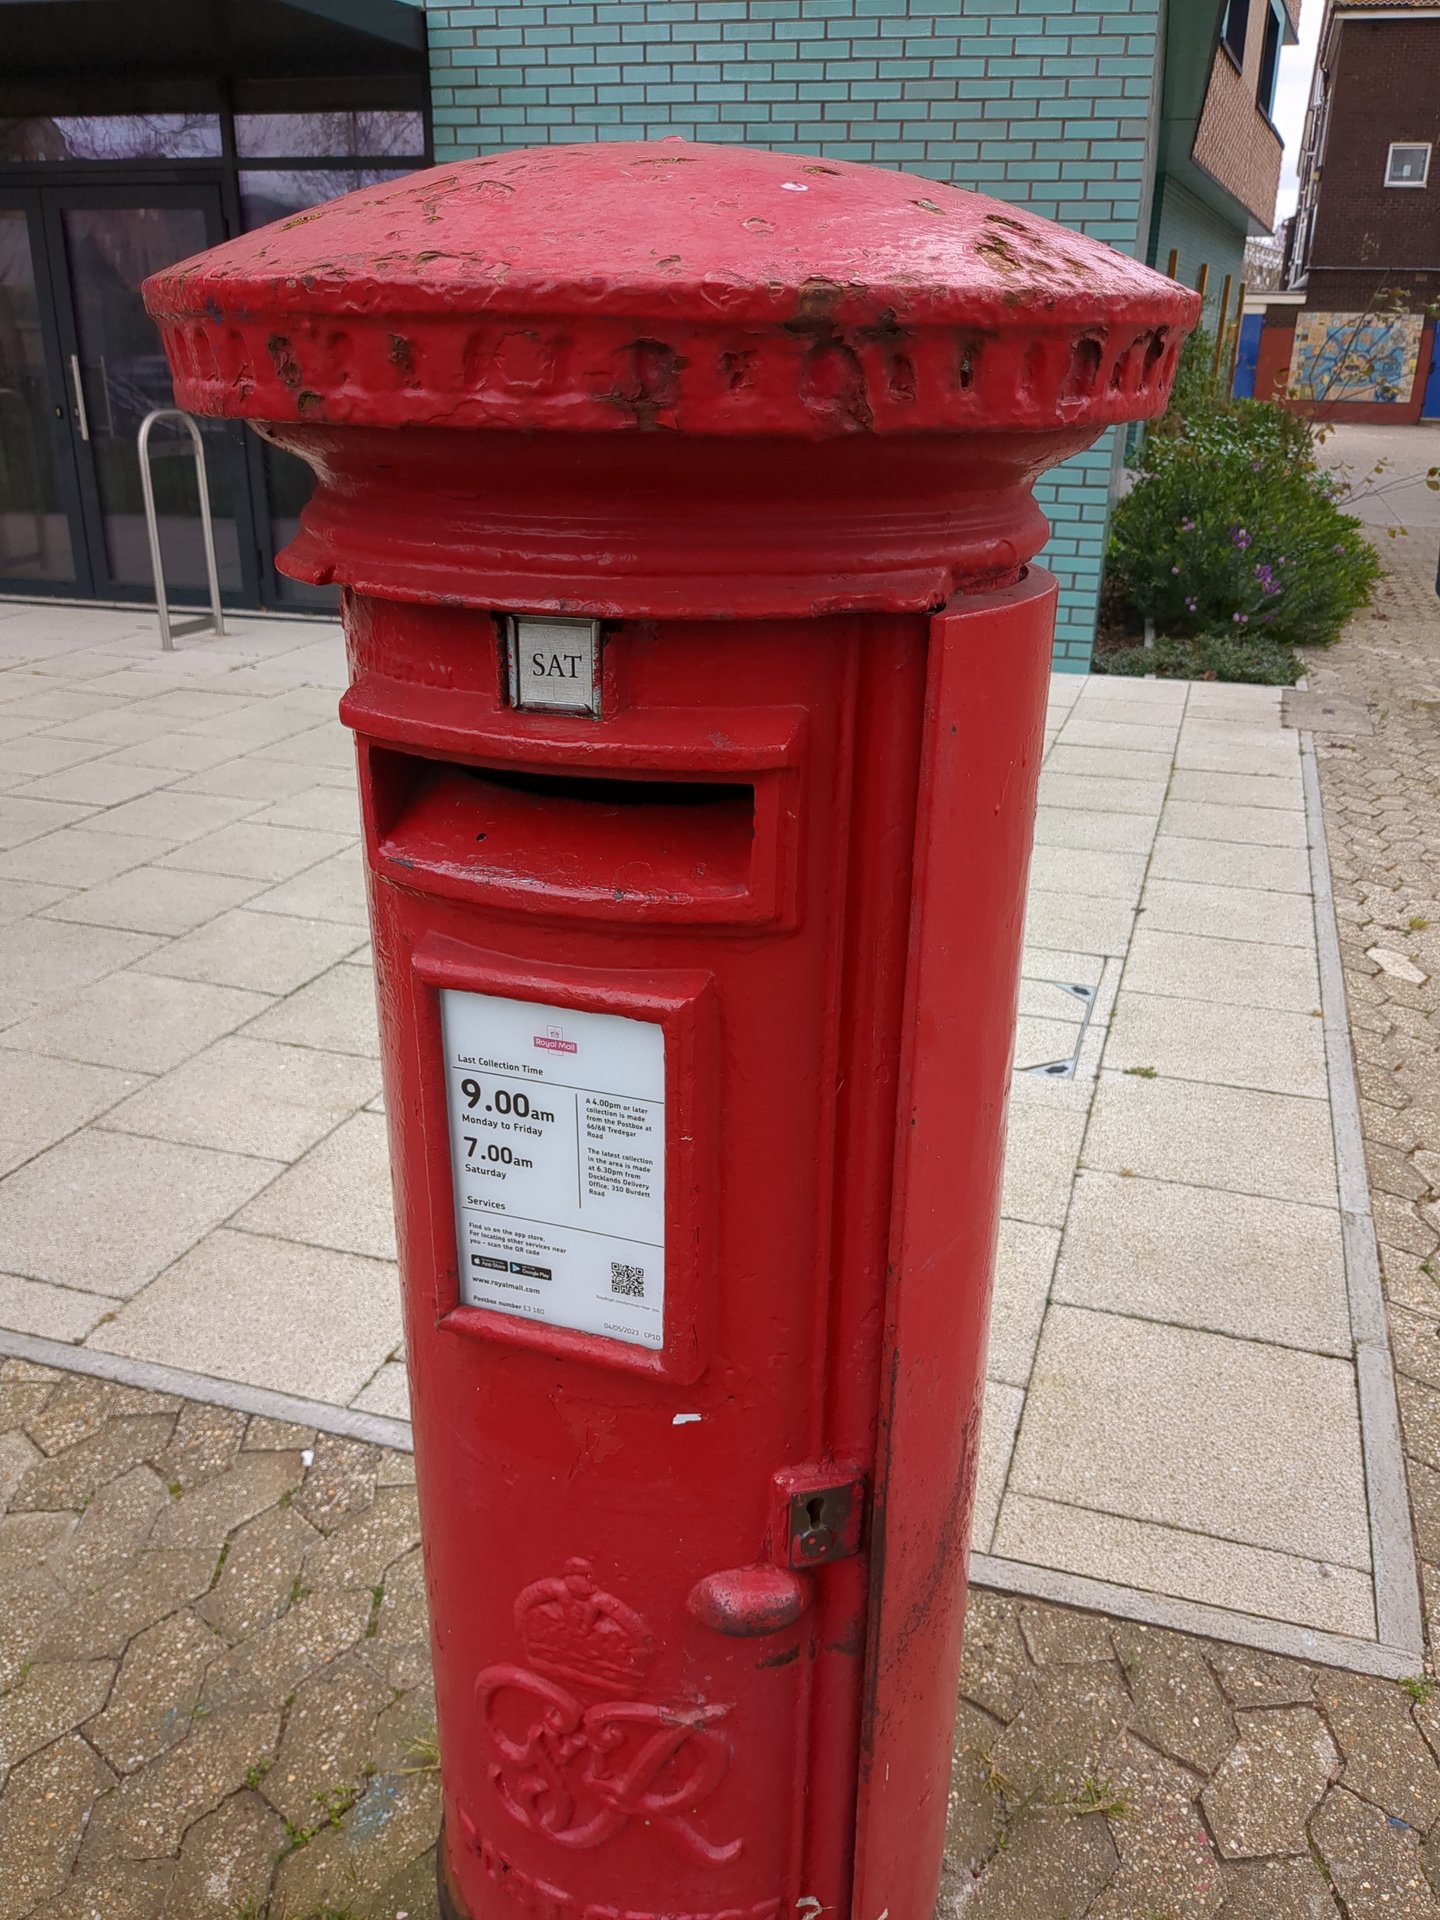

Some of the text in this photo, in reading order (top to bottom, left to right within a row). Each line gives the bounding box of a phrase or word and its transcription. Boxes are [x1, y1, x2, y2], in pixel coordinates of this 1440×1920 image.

[533, 653, 582, 678] SAT
[536, 1038, 575, 1051] Royal Mail
[457, 1053, 544, 1076] Last Collection Time
[461, 1078, 555, 1123] 9.00am
[592, 1098, 621, 1110] 4.00pm
[632, 1105, 648, 1114] later
[586, 1107, 645, 1122] collection is made
[586, 1114, 603, 1123] from
[604, 1117, 615, 1125] the
[617, 1120, 643, 1130] Postbox
[462, 1113, 543, 1137] Monday to Friday
[586, 1123, 637, 1137] 66/68 Tredegar
[587, 1131, 604, 1140] Road
[463, 1136, 533, 1169] 7.00am
[587, 1147, 654, 1165] The latest collection
[465, 1163, 507, 1180] Saturday
[596, 1157, 607, 1165] the
[608, 1160, 623, 1168] area
[632, 1165, 651, 1173] made
[596, 1165, 623, 1176] 6.30pm
[625, 1171, 641, 1180] from
[588, 1172, 650, 1191] Docklands Delivery
[589, 1188, 605, 1197] Road
[611, 1184, 624, 1193] 310
[625, 1187, 651, 1198] Burdett
[467, 1195, 506, 1210] Services
[468, 1222, 482, 1230] Find
[502, 1228, 513, 1236] the
[514, 1231, 526, 1239] app
[481, 1231, 506, 1242] locating
[507, 1237, 524, 1245] other
[525, 1241, 551, 1251] services
[503, 1243, 513, 1251] the
[525, 1248, 540, 1256] code
[472, 1276, 541, 1294] www.royalmail.com
[473, 1295, 497, 1304] Postbox
[498, 1301, 522, 1309] number
